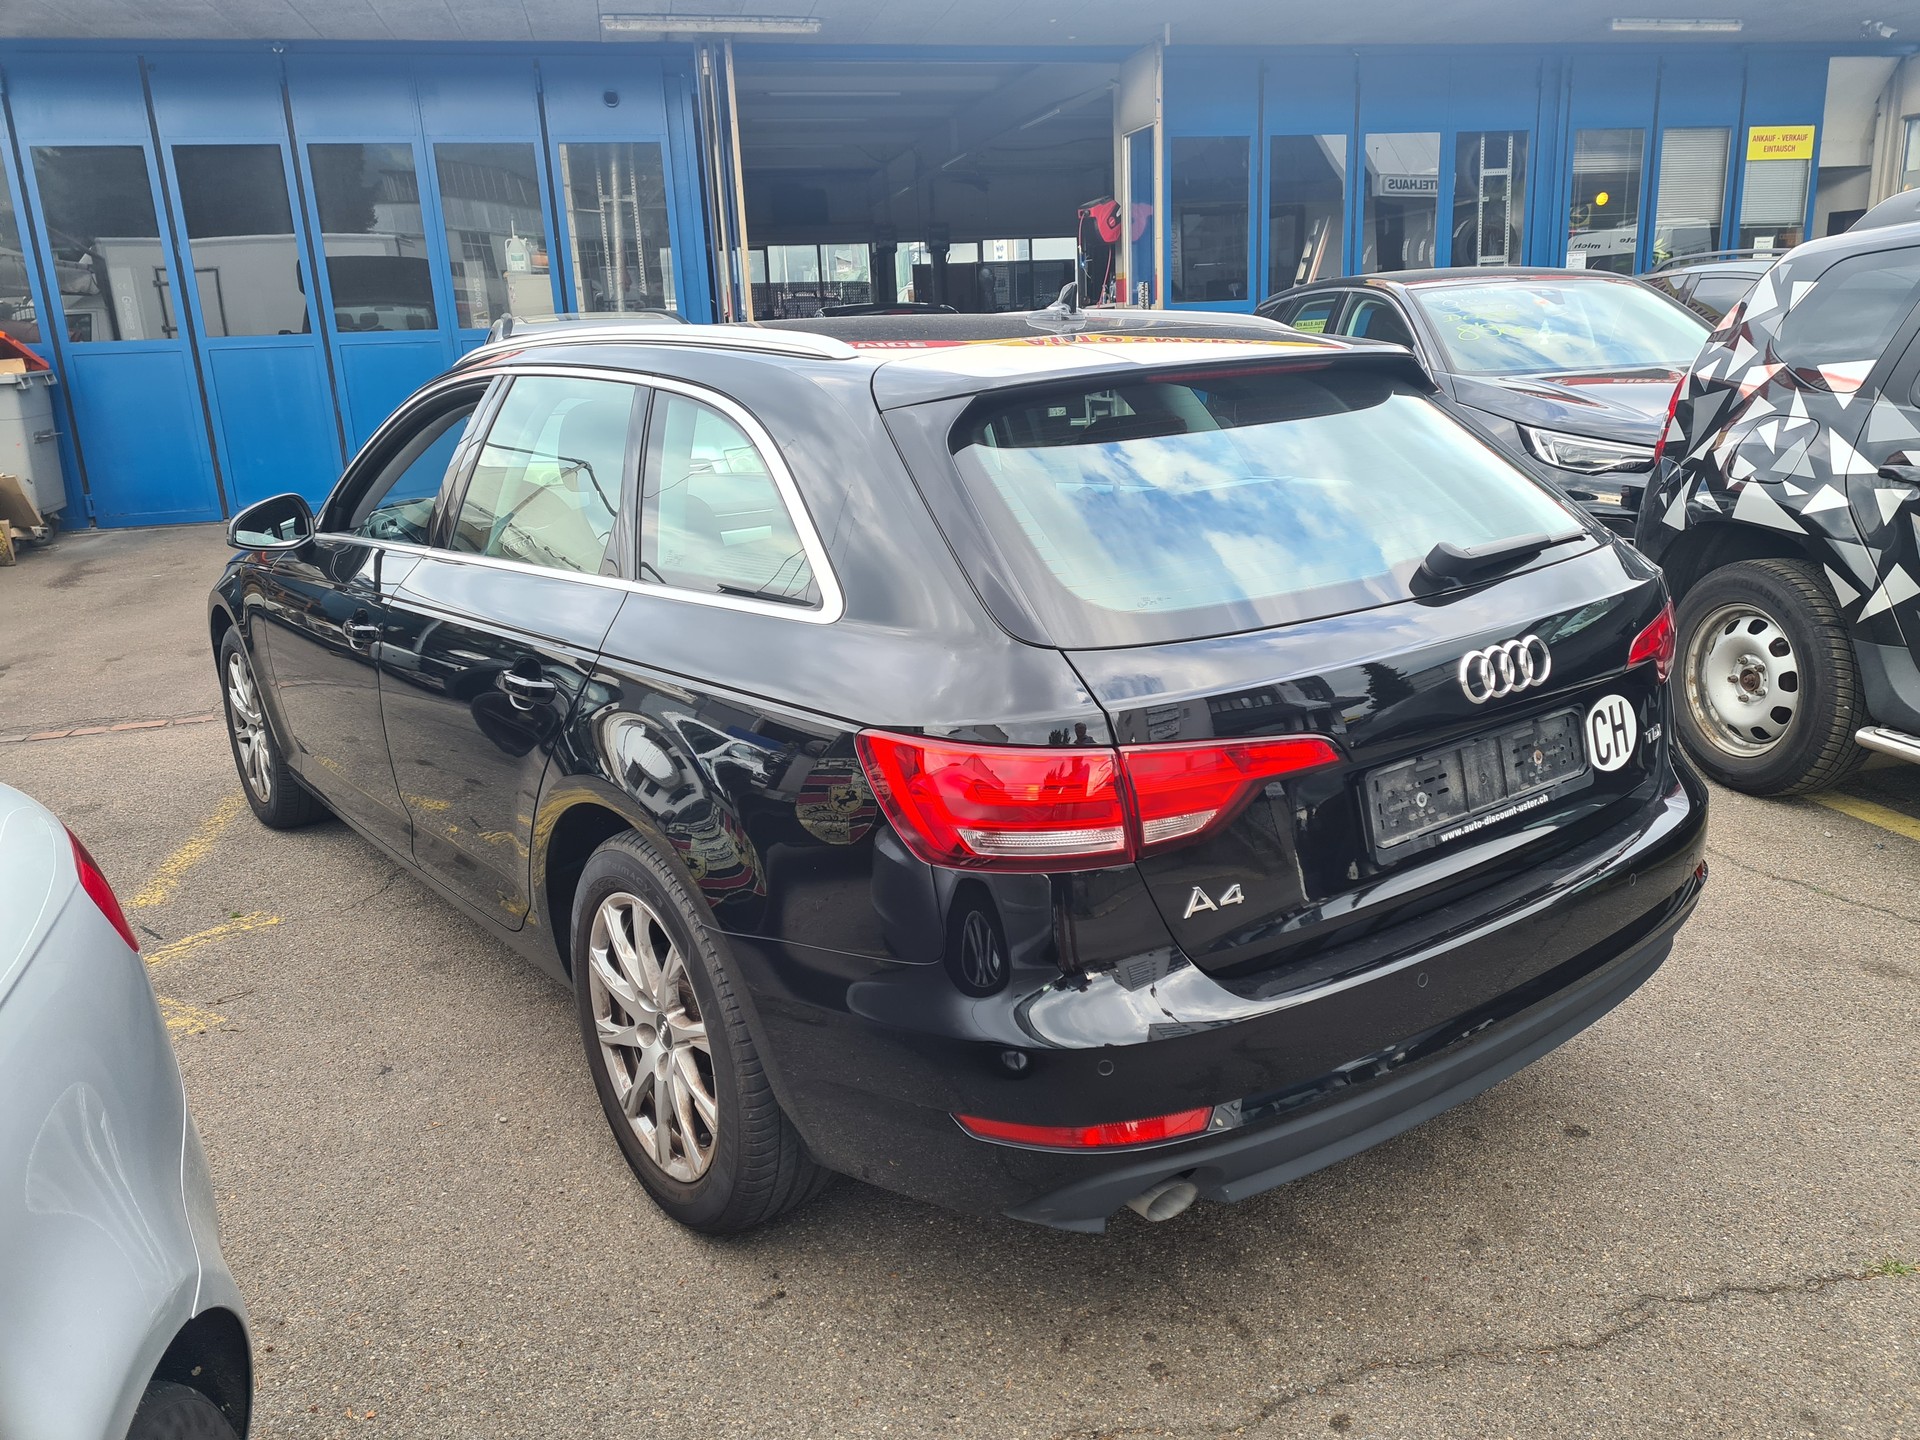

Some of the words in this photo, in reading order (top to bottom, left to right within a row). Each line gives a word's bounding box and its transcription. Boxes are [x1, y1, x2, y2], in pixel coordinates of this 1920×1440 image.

[1752, 134, 1776, 143] ANKAUF
[1782, 133, 1809, 142] VERKAUF
[1763, 145, 1796, 153] EINTAUSCH
[1591, 700, 1630, 767] CH
[1440, 793, 1549, 842] www.auto-discount-uster.ch
[1182, 883, 1245, 920] A4
